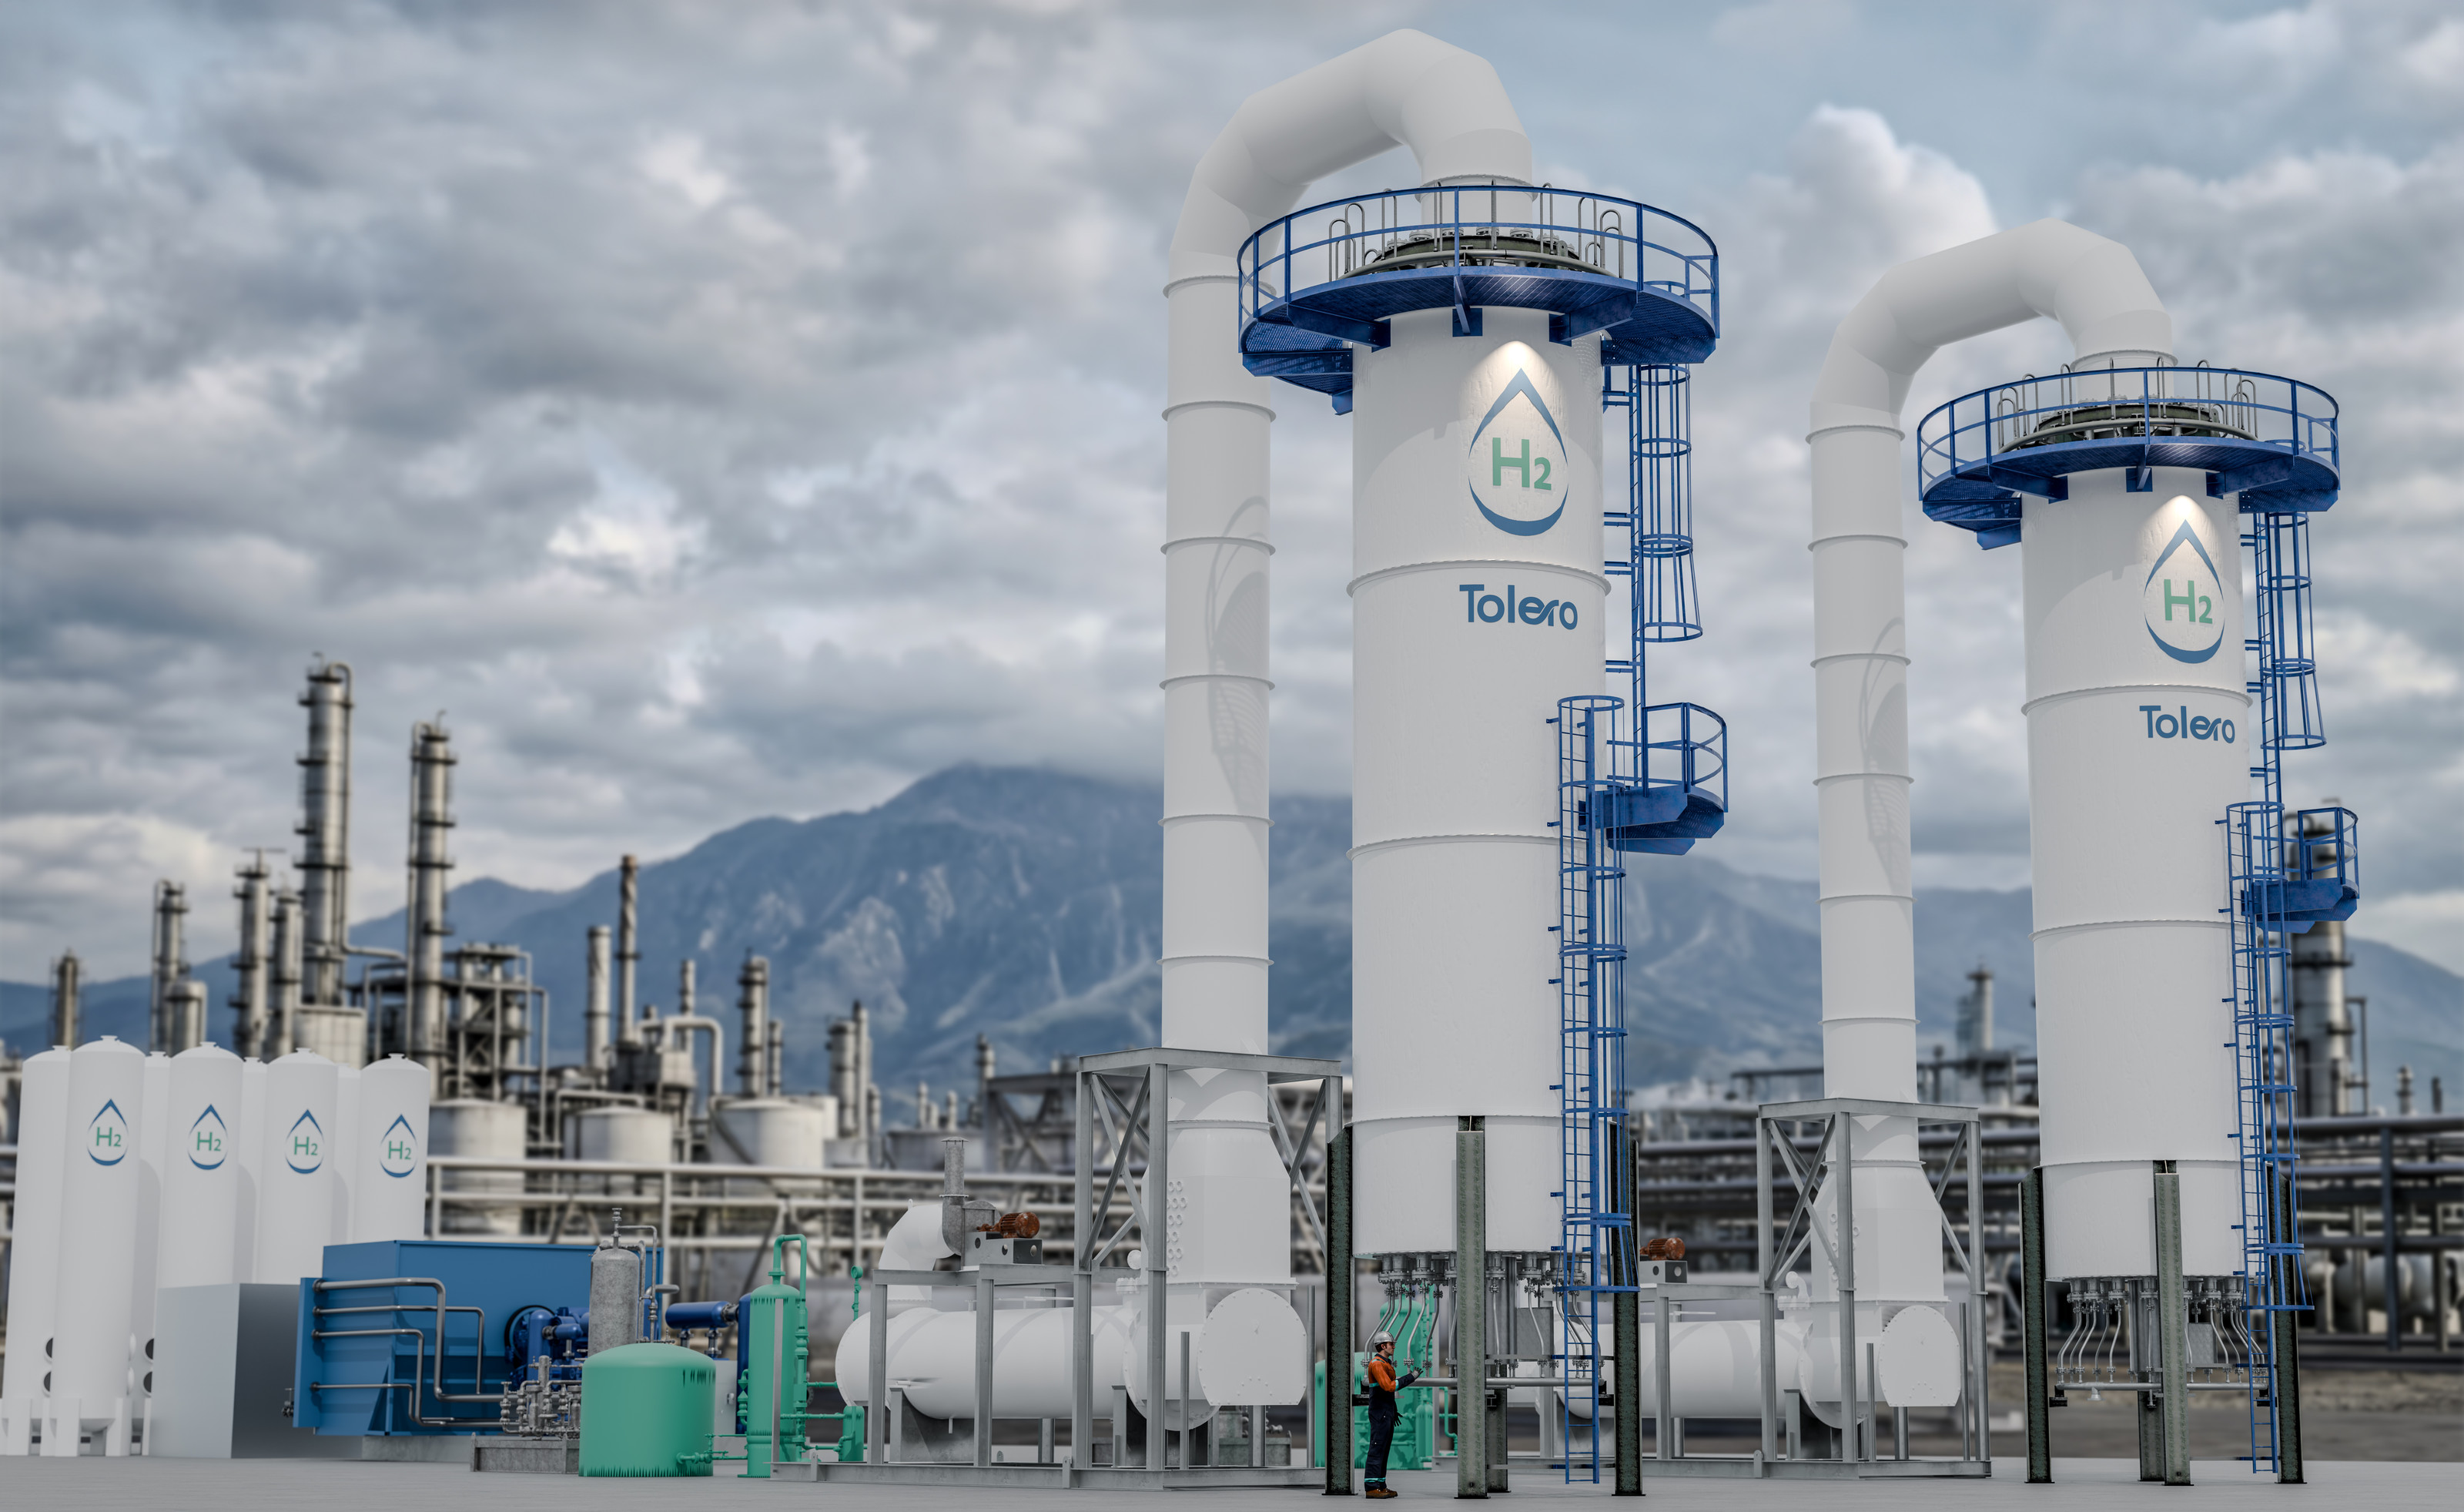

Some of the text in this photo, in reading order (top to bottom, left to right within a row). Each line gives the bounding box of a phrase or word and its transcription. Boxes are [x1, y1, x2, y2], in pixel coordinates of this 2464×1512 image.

[1492, 437, 1552, 491] H2
[1459, 584, 1578, 630] Tolero
[2164, 579, 2213, 625] H2
[2139, 705, 2235, 743] Tolero
[96, 1127, 122, 1147] H2
[197, 1131, 222, 1152] H2
[294, 1136, 318, 1156] H2
[388, 1141, 411, 1160] H2
